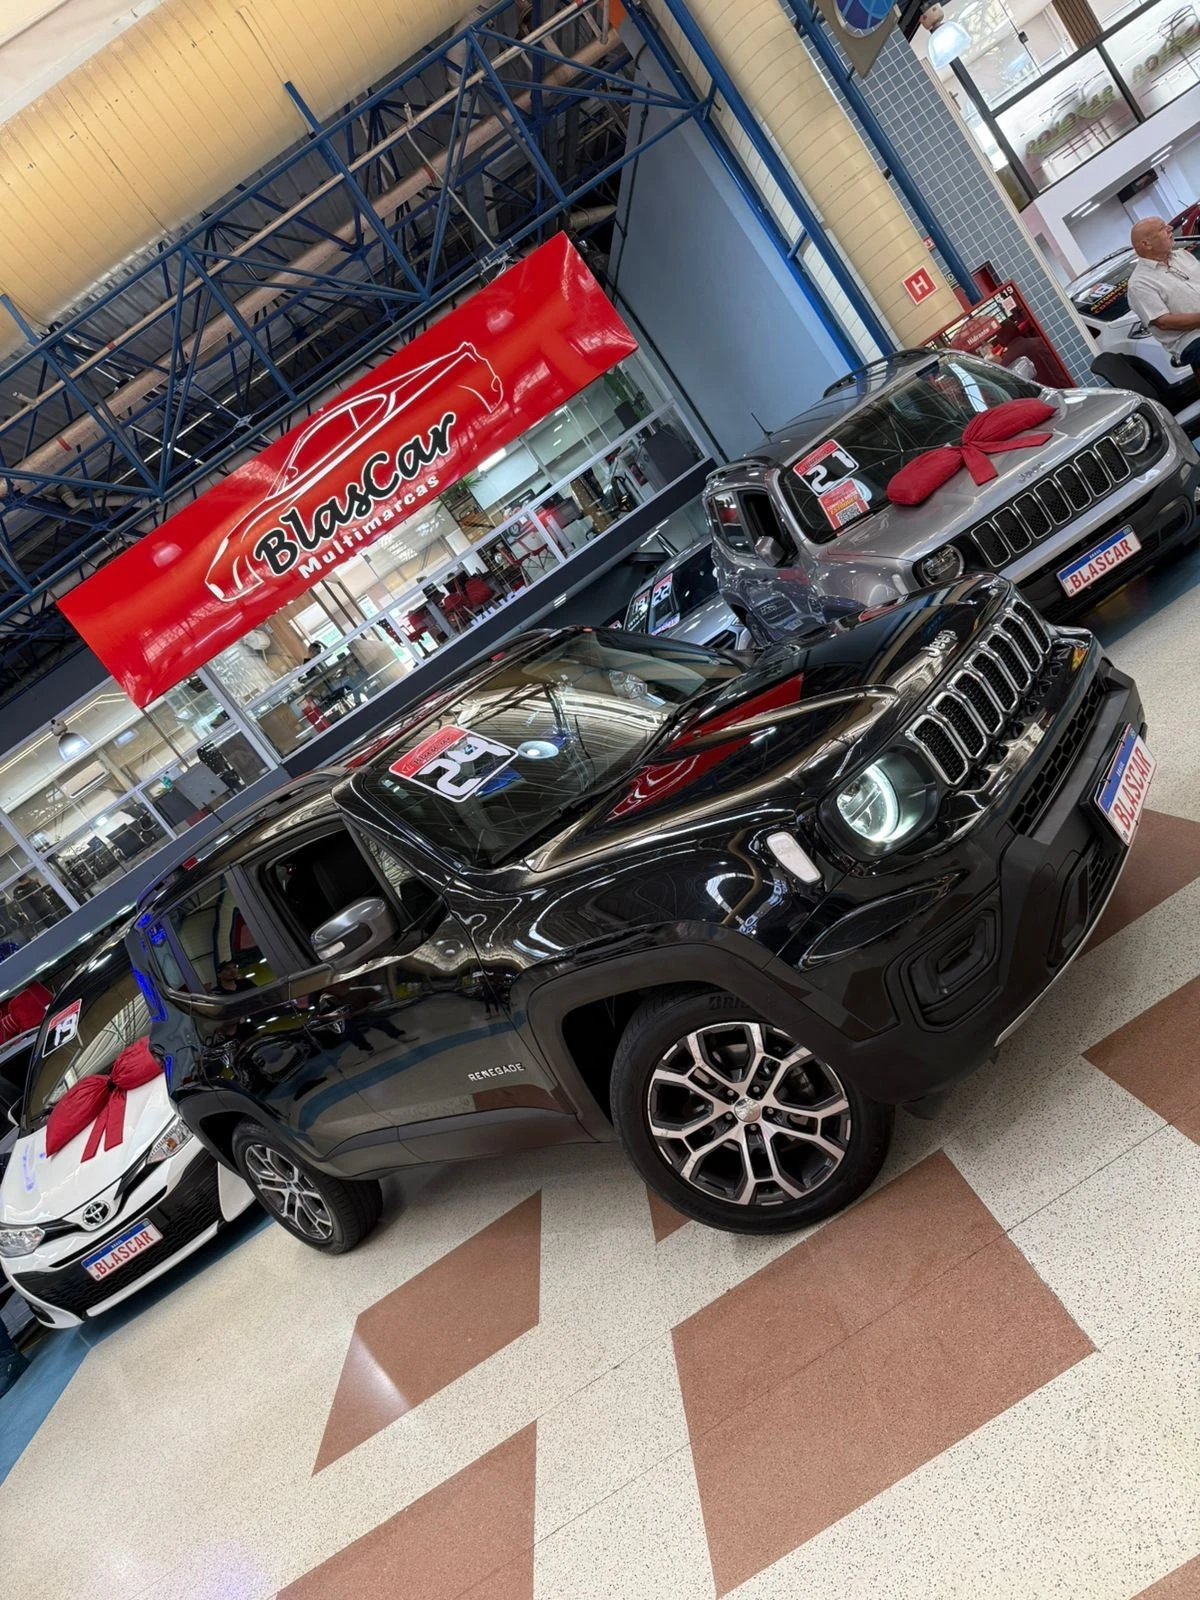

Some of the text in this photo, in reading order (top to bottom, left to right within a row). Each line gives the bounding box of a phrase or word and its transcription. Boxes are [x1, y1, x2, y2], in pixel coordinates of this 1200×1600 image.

[911, 275, 929, 295] H
[805, 450, 855, 493] 21
[253, 411, 457, 577] BlasCar
[298, 475, 440, 579] Multimarcas
[1069, 539, 1133, 590] BLASCAR
[652, 585, 671, 607] 22
[920, 629, 958, 657] Jeep
[1113, 746, 1152, 832] BLASCAR
[467, 1062, 525, 1082] RENEGADE
[94, 1231, 154, 1276] BLASCAR
